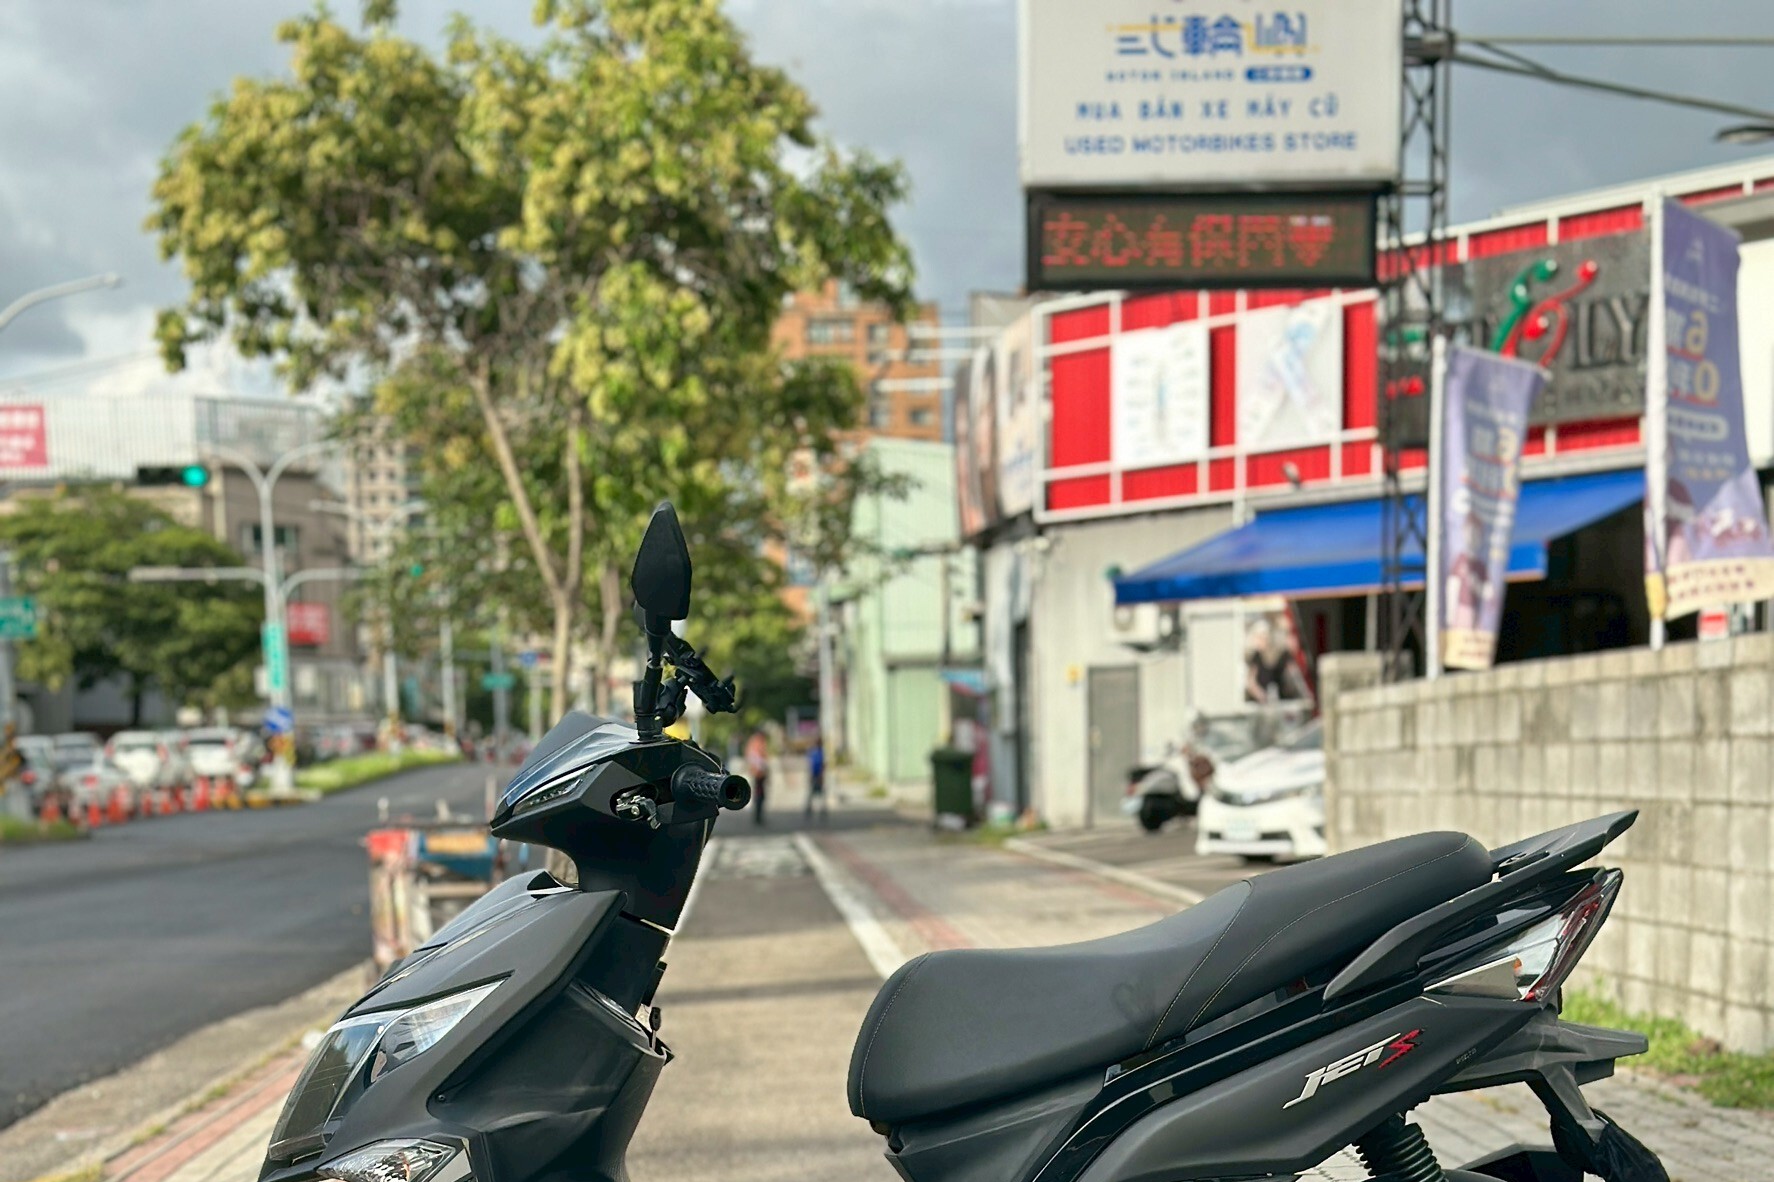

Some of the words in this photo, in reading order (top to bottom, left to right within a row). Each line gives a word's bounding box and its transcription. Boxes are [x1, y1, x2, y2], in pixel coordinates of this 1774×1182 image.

[1064, 135, 1125, 154] USED
[1132, 132, 1275, 153] MOTORBIKES
[1283, 130, 1357, 151] STORE
